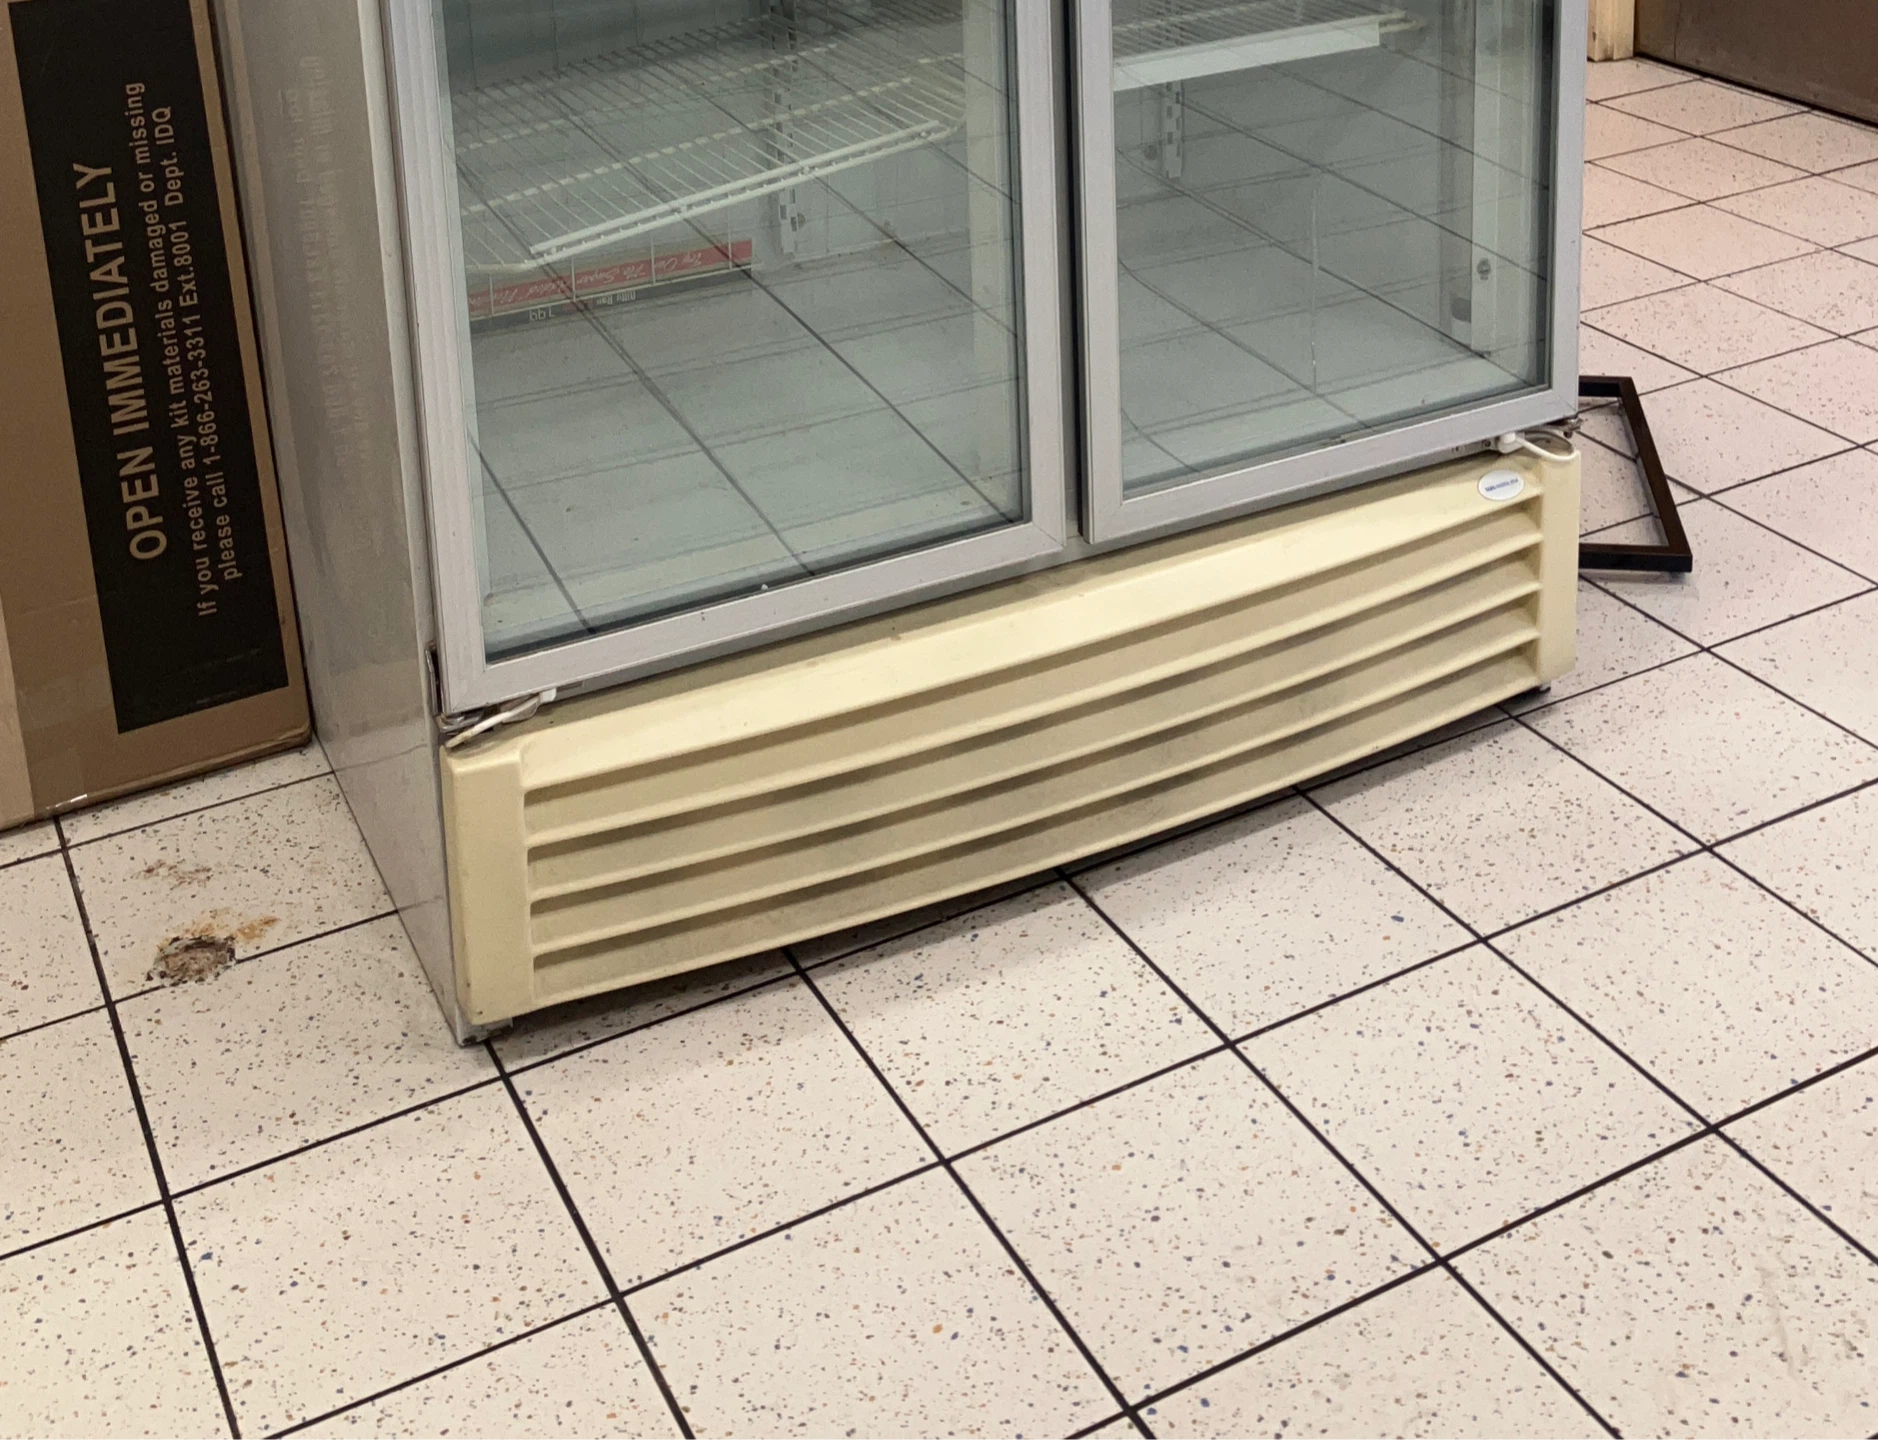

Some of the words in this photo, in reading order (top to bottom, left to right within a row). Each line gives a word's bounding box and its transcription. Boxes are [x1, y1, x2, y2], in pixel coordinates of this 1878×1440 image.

[124, 83, 151, 163] missing
[152, 107, 175, 145] IDQ
[137, 171, 155, 192] or
[160, 152, 185, 206] Dept.
[138, 200, 170, 292] damaged
[168, 221, 198, 307] Ext.8001
[72, 163, 149, 435] IMMEDIATELY
[154, 299, 185, 394] materials
[169, 400, 190, 427] kit
[182, 314, 221, 465] 1-866-263-3311
[177, 435, 197, 469] any
[117, 446, 167, 559] OPEN
[182, 476, 208, 550] receive
[206, 472, 228, 507] call
[195, 557, 219, 595] you
[215, 515, 243, 580] please
[197, 601, 217, 616] If
